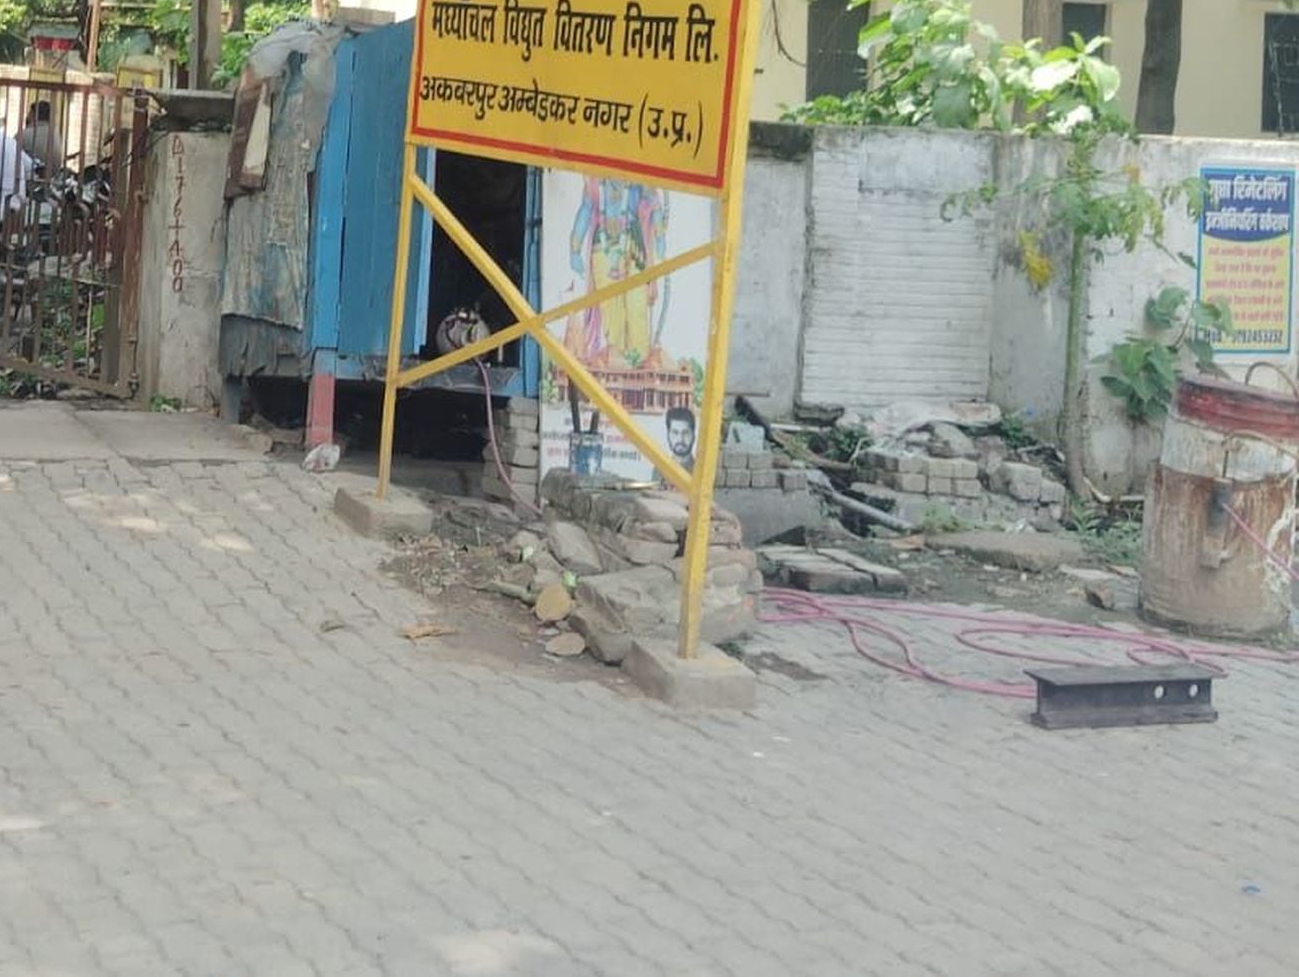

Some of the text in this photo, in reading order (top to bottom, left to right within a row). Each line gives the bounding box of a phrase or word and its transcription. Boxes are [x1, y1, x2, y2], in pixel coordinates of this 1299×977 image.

[623, 1, 679, 61] निगम
[685, 3, 719, 63] लि.
[420, 76, 498, 120] अकबरपुर
[583, 97, 634, 133] नगर
